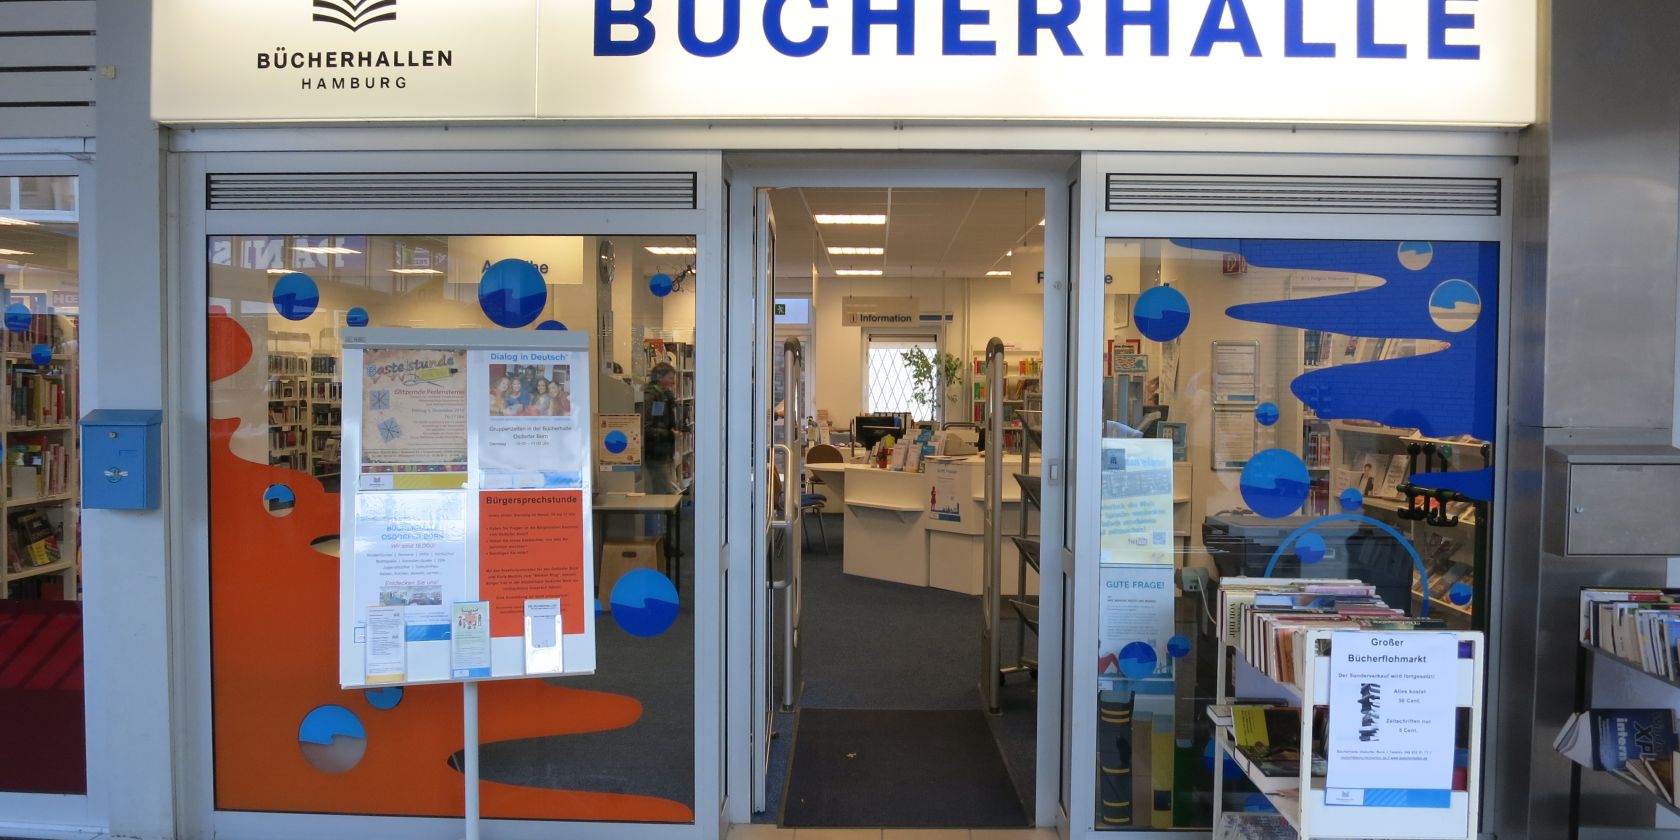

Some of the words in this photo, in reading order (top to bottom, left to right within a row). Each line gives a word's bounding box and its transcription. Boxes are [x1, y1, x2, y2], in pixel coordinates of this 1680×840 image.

[257, 46, 452, 69] BÜCHERHALLEN
[301, 76, 407, 90] HAMBURG
[860, 313, 912, 322] Information
[490, 352, 518, 362] Dialog
[520, 352, 529, 361] in
[486, 495, 577, 505] Bürgersprechstunde
[1105, 580, 1130, 589] GUTE
[1132, 580, 1165, 590] FRAGE!
[1371, 637, 1404, 647] Großer
[1348, 653, 1427, 664] Bücherflohmarkt
[1616, 718, 1628, 761] intern
